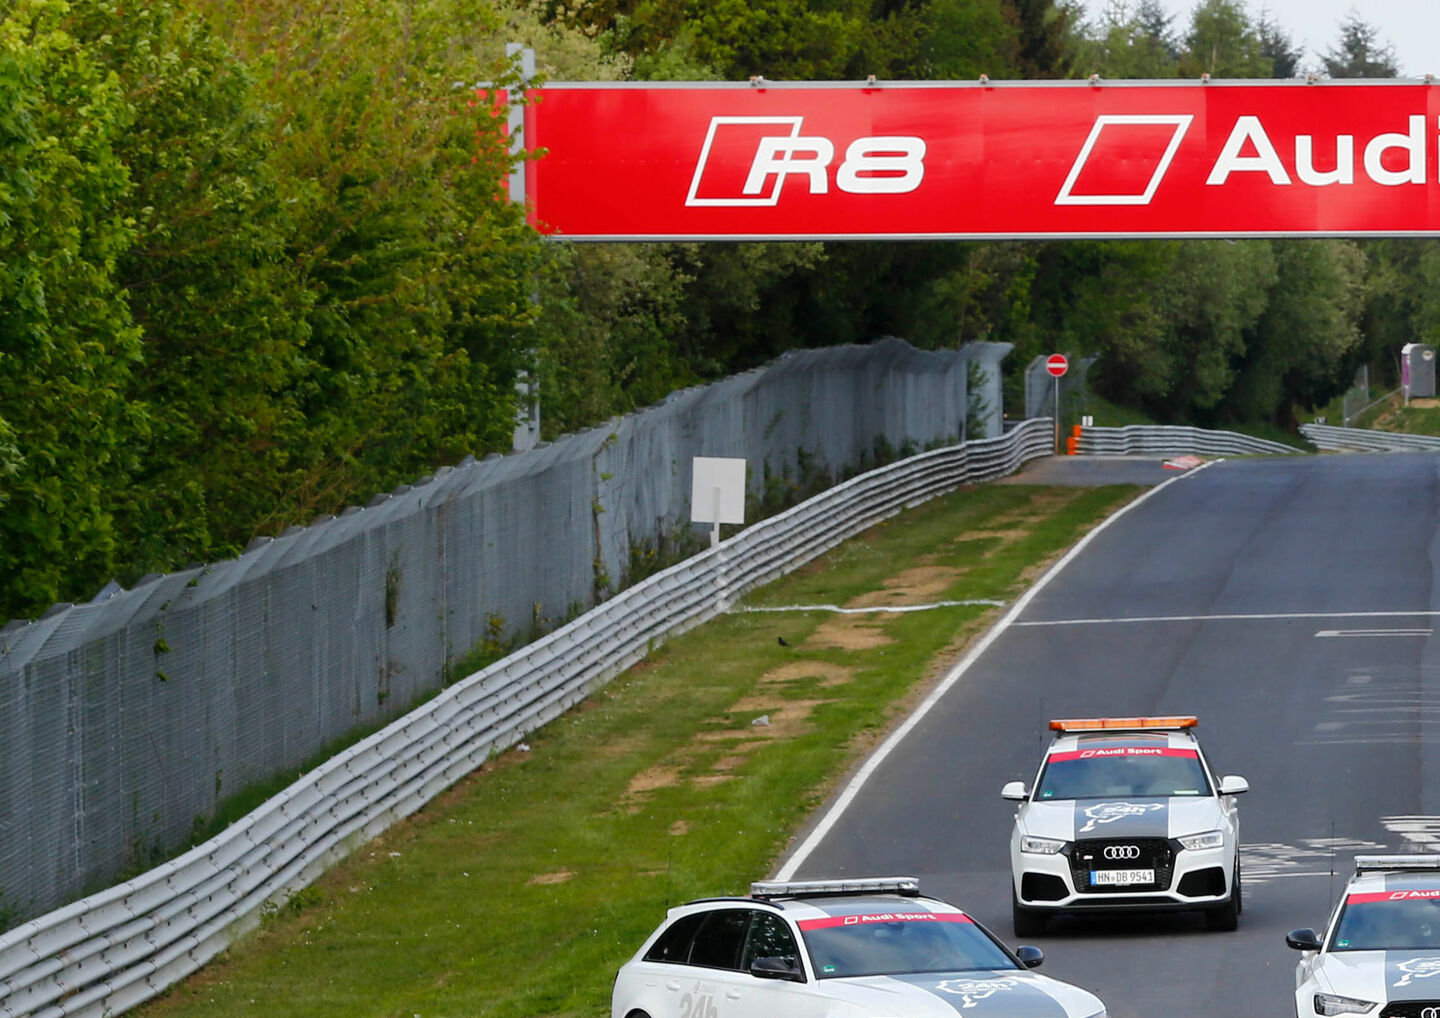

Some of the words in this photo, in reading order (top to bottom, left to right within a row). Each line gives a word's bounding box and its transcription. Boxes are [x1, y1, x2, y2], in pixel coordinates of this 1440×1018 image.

[742, 135, 927, 198] R8
[1127, 748, 1162, 756] Sport
[1097, 872, 1110, 882] HN
[1129, 871, 1153, 882] 9541
[861, 914, 893, 922] Audi
